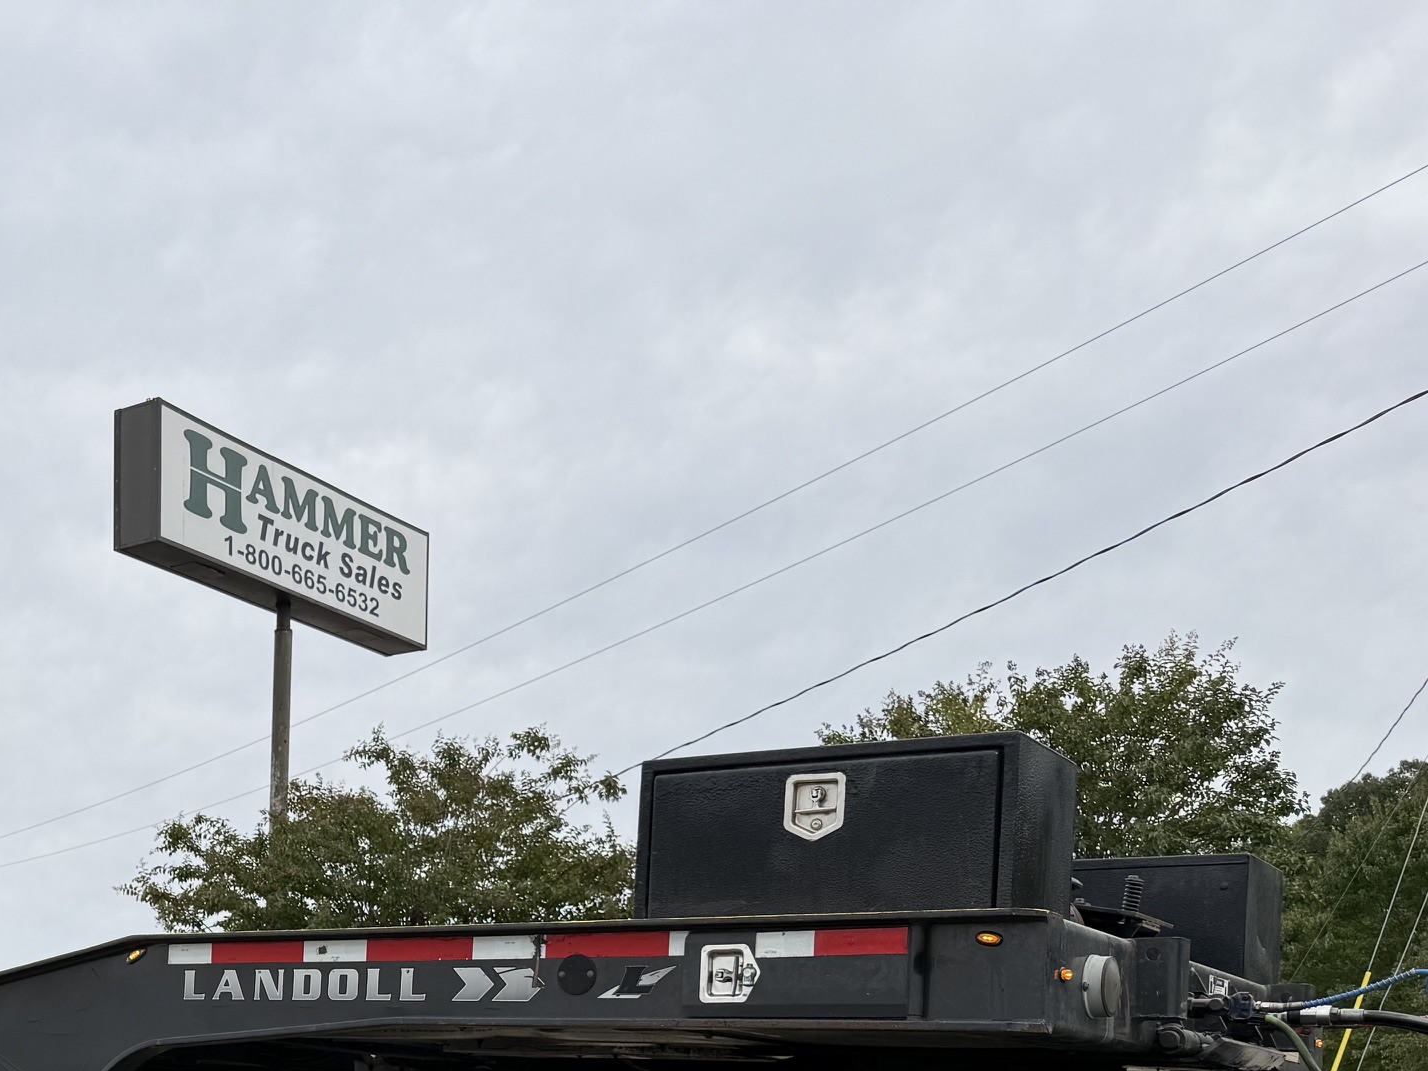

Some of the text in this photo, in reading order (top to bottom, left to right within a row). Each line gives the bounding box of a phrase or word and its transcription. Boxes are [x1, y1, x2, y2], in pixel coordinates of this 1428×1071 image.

[183, 428, 411, 575] HAMMER
[224, 535, 380, 617] 1-800-665-6532
[257, 513, 403, 600] Truck Sales
[183, 968, 427, 1001] LANDOLL
